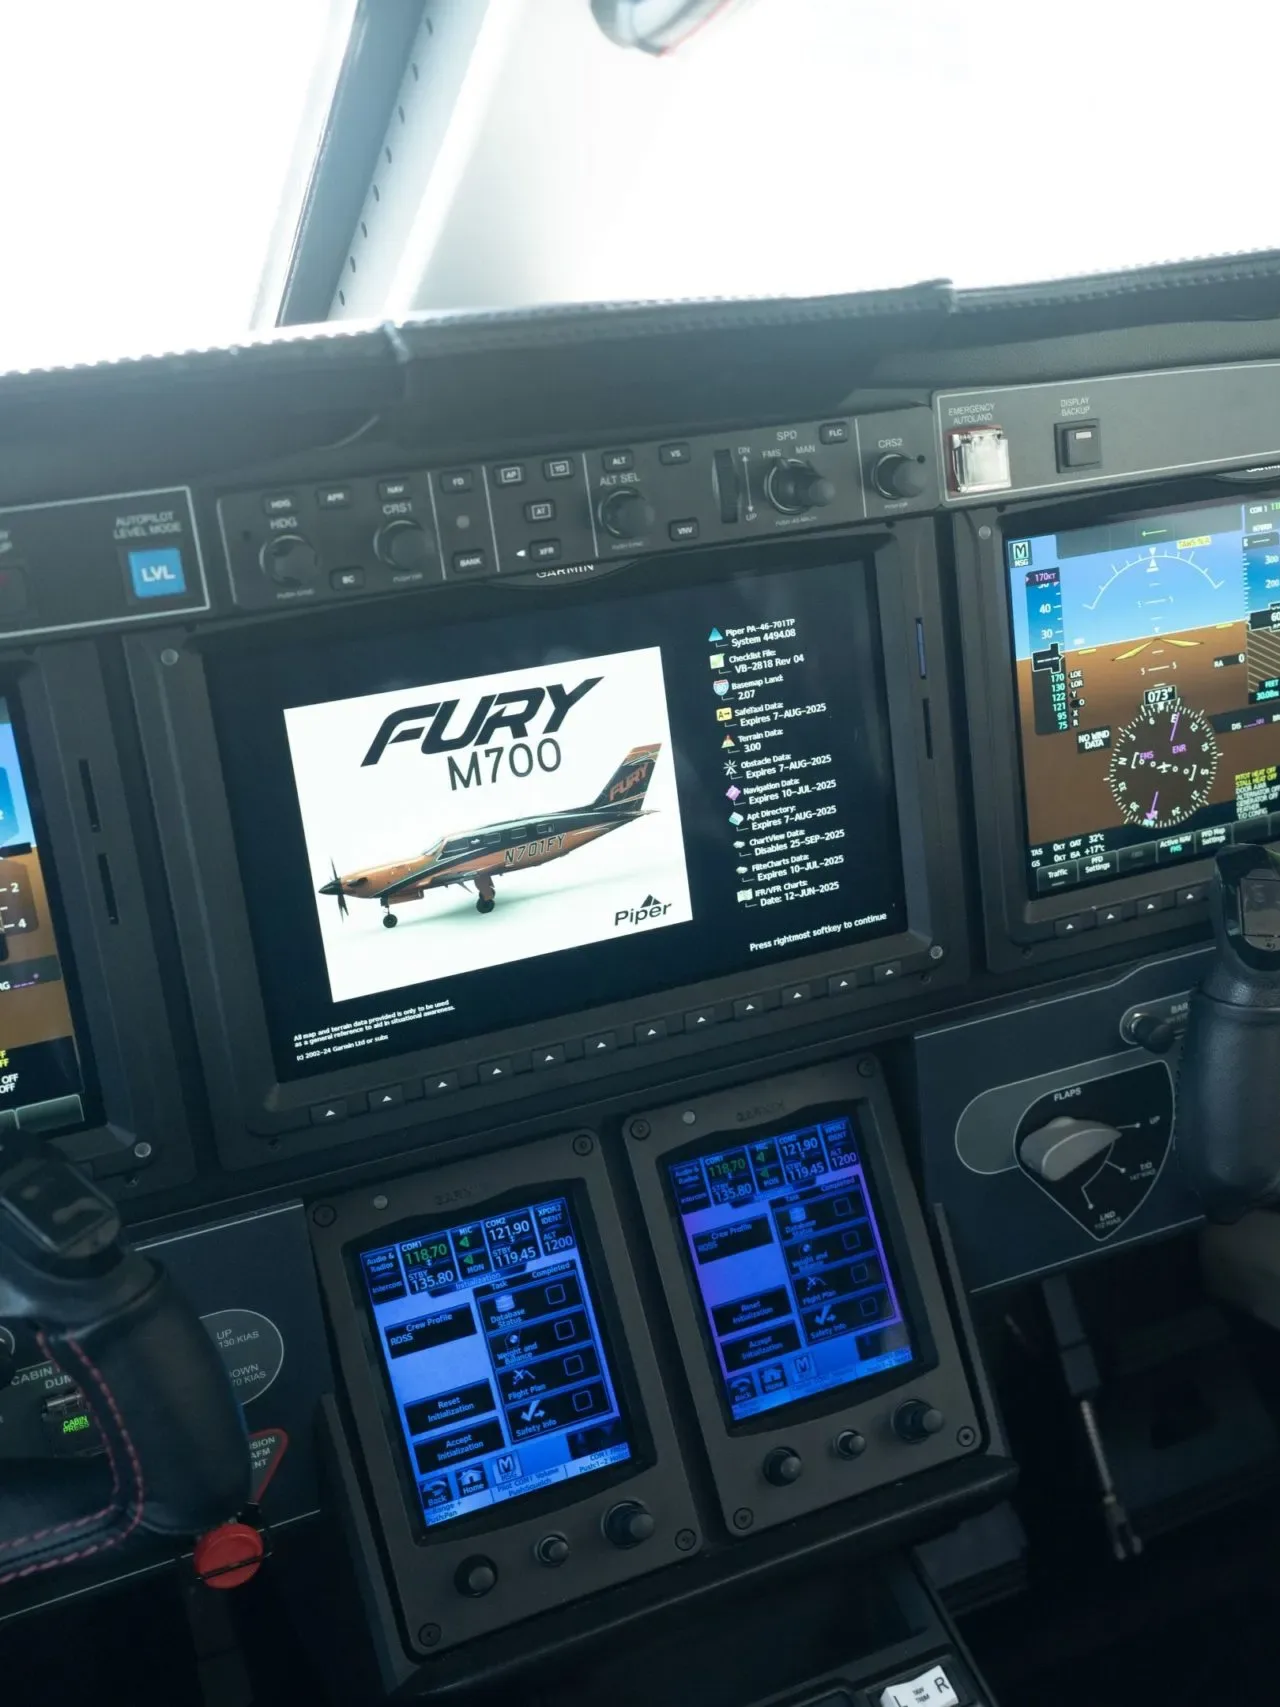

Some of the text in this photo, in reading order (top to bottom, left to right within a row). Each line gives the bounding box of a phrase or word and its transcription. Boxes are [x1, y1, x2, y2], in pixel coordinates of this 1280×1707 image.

[1060, 397, 1089, 408] DISPLAY
[948, 403, 995, 416] EMERGENCY
[1061, 405, 1089, 417] BACKUP
[953, 413, 992, 425] AUTOLAND
[776, 430, 797, 441] SPD
[829, 429, 844, 437] FLC
[796, 444, 816, 455] MAN
[877, 438, 904, 449] CRS2
[612, 456, 626, 466] ALT
[600, 471, 641, 486] ALT SEL
[383, 502, 412, 515] CRS1
[115, 511, 175, 527] AUTOPILOT
[271, 516, 298, 530] HDG
[113, 521, 182, 539] LEVEL MODE
[141, 565, 176, 582] LVL
[1039, 603, 1052, 614] 40
[725, 618, 795, 638] Piper PA-46-701TP
[1041, 628, 1053, 640] 30
[731, 629, 796, 648] System 4494.08
[729, 652, 761, 664] Checklist
[735, 654, 805, 674] VB-2818 Rev 04
[731, 678, 763, 690] Basemap
[1051, 673, 1065, 683] 170
[1052, 683, 1066, 693] 130
[738, 690, 755, 700] 2.07
[1052, 693, 1066, 703] 122
[1147, 687, 1172, 703] 073°
[1053, 702, 1066, 713] 121
[360, 676, 605, 767] FURY
[740, 703, 827, 727] Expires 7-AUG-2025
[1057, 712, 1068, 722] 95
[1058, 721, 1069, 730] 75
[738, 732, 764, 743] Terrain
[744, 743, 761, 753] 3.00
[1084, 739, 1105, 750] DATA
[1172, 744, 1186, 754] ENR
[447, 737, 562, 791] M700
[741, 757, 772, 769] Obstacle
[746, 754, 832, 779] Expires 7-AUG-2025
[608, 765, 648, 801] FURY
[743, 781, 780, 795] Navigation
[749, 779, 836, 805] Expires 10-JUL-2025
[747, 811, 760, 821] Apt
[752, 805, 836, 831] Expires 7-AUG-2025
[749, 833, 785, 846] ChartView
[754, 829, 845, 856] Disables 25-SEP-2025
[504, 834, 566, 865] N701FY
[1031, 848, 1043, 857] TAS
[757, 855, 844, 882] Expires 10-JUL-2025
[1031, 860, 1041, 868] GS
[1085, 863, 1110, 873] Settings
[1048, 868, 1068, 878] Traffic
[755, 885, 782, 898] IFR/VFR
[760, 881, 840, 907] Date: 12-JUN-2025
[614, 901, 672, 926] Piper
[750, 912, 887, 951] Press rightmost softkey to continue
[368, 1012, 396, 1025] provided
[1054, 1087, 1082, 1102] FLAPS
[1149, 1115, 1160, 1124] UP
[783, 1137, 819, 1157] 121.90
[832, 1152, 857, 1168] 1200
[709, 1159, 747, 1179] 118.70
[789, 1161, 826, 1181] 119.45
[821, 1177, 855, 1192] Completed
[715, 1183, 752, 1202] 135.80
[541, 1213, 562, 1225] IDENT
[1099, 1210, 1116, 1222] LND
[486, 1217, 506, 1229] COM2
[460, 1226, 473, 1235] MIC
[489, 1220, 530, 1241] 121.90
[401, 1241, 423, 1252] COM1
[545, 1235, 573, 1252] 1200
[405, 1243, 448, 1265] 118.70
[492, 1246, 511, 1257] STBY
[496, 1246, 536, 1267] 119.45
[367, 1255, 387, 1265] Audio
[370, 1262, 394, 1273] Radios
[408, 1270, 428, 1281] STBY
[413, 1270, 454, 1292] 135.80
[492, 1262, 571, 1291] Task Completed
[372, 1281, 403, 1294] Intercom
[491, 1308, 526, 1325] Database
[733, 1307, 774, 1324] Initialization
[406, 1313, 453, 1333] Crew Profile
[499, 1316, 523, 1330] Status
[217, 1329, 232, 1341] UP
[219, 1331, 260, 1349] 130 KIAS
[391, 1333, 414, 1346] ROSS
[524, 1342, 538, 1352] and
[741, 1342, 784, 1360] Initialization
[11, 1366, 53, 1387] CABIN
[230, 1363, 259, 1379] OWN
[245, 1370, 267, 1384] KIAS
[508, 1384, 546, 1401] Flight Plan
[438, 1397, 461, 1409] Reset
[427, 1402, 475, 1422] Initialization
[63, 1415, 88, 1428] CABIN
[63, 1422, 91, 1434] PRESS
[516, 1418, 557, 1437] Safety Info
[446, 1434, 472, 1449] Accept
[251, 1447, 271, 1460] AFM
[437, 1441, 484, 1461] Initialization
[463, 1483, 485, 1495] Home
[428, 1495, 447, 1507] Back
[934, 1676, 950, 1694] R
[915, 1693, 931, 1705] TRIM
